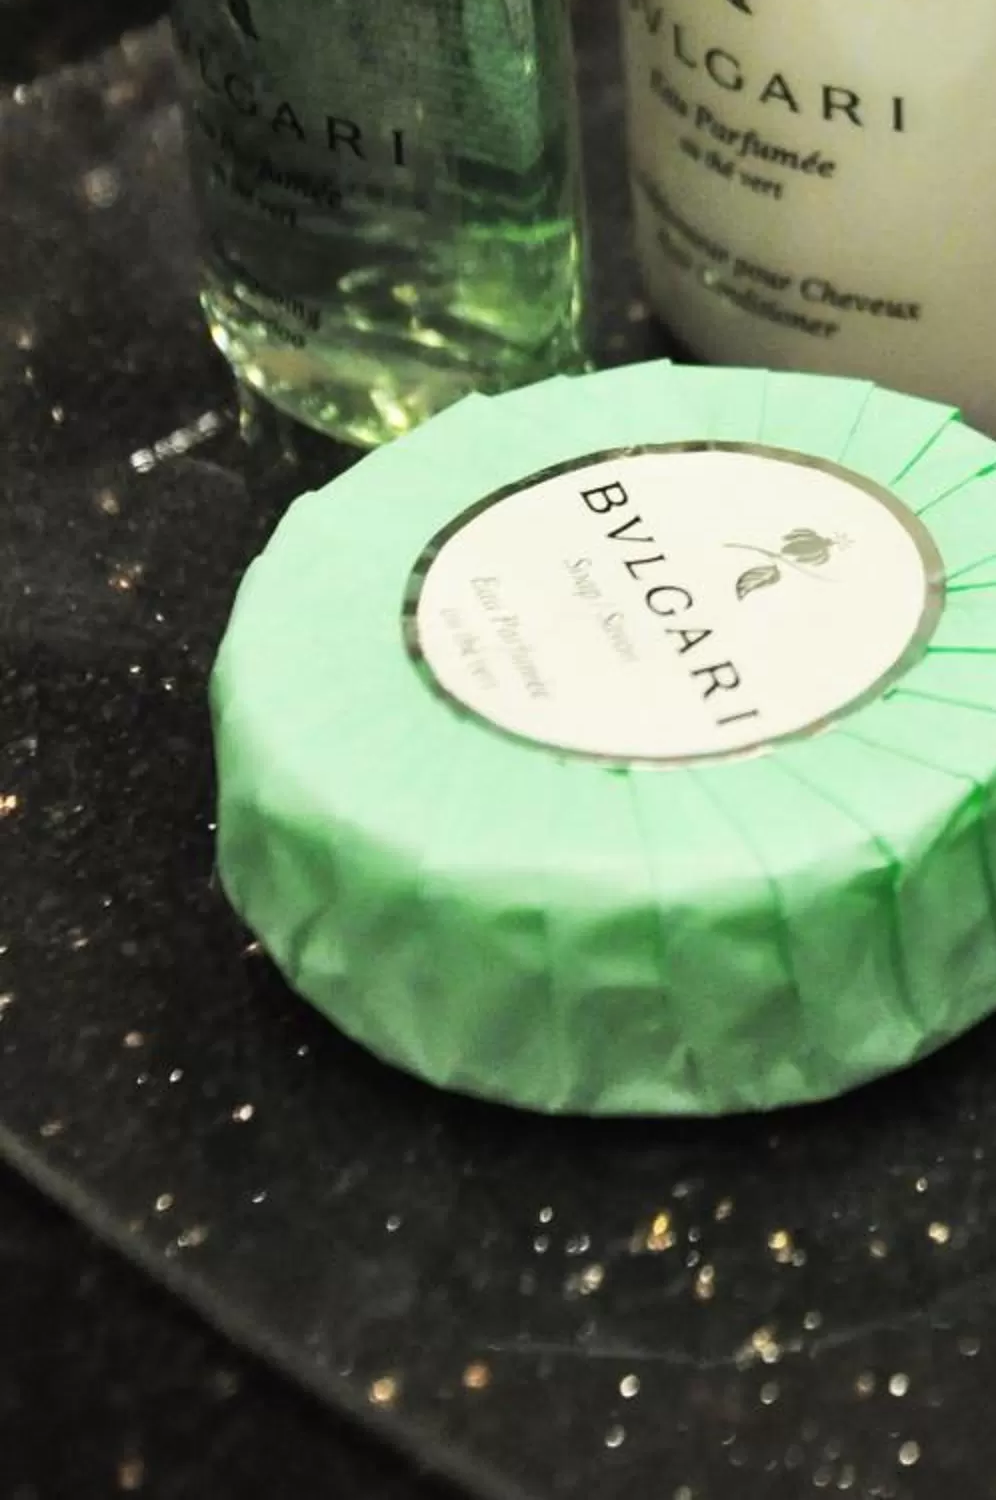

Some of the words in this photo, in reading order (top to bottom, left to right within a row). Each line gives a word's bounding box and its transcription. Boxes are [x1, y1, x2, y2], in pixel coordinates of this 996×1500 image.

[197, 46, 407, 168] LGARI
[694, 103, 837, 180] Parfumée
[799, 276, 920, 322] Cheveux
[580, 480, 760, 727] BVLGARI
